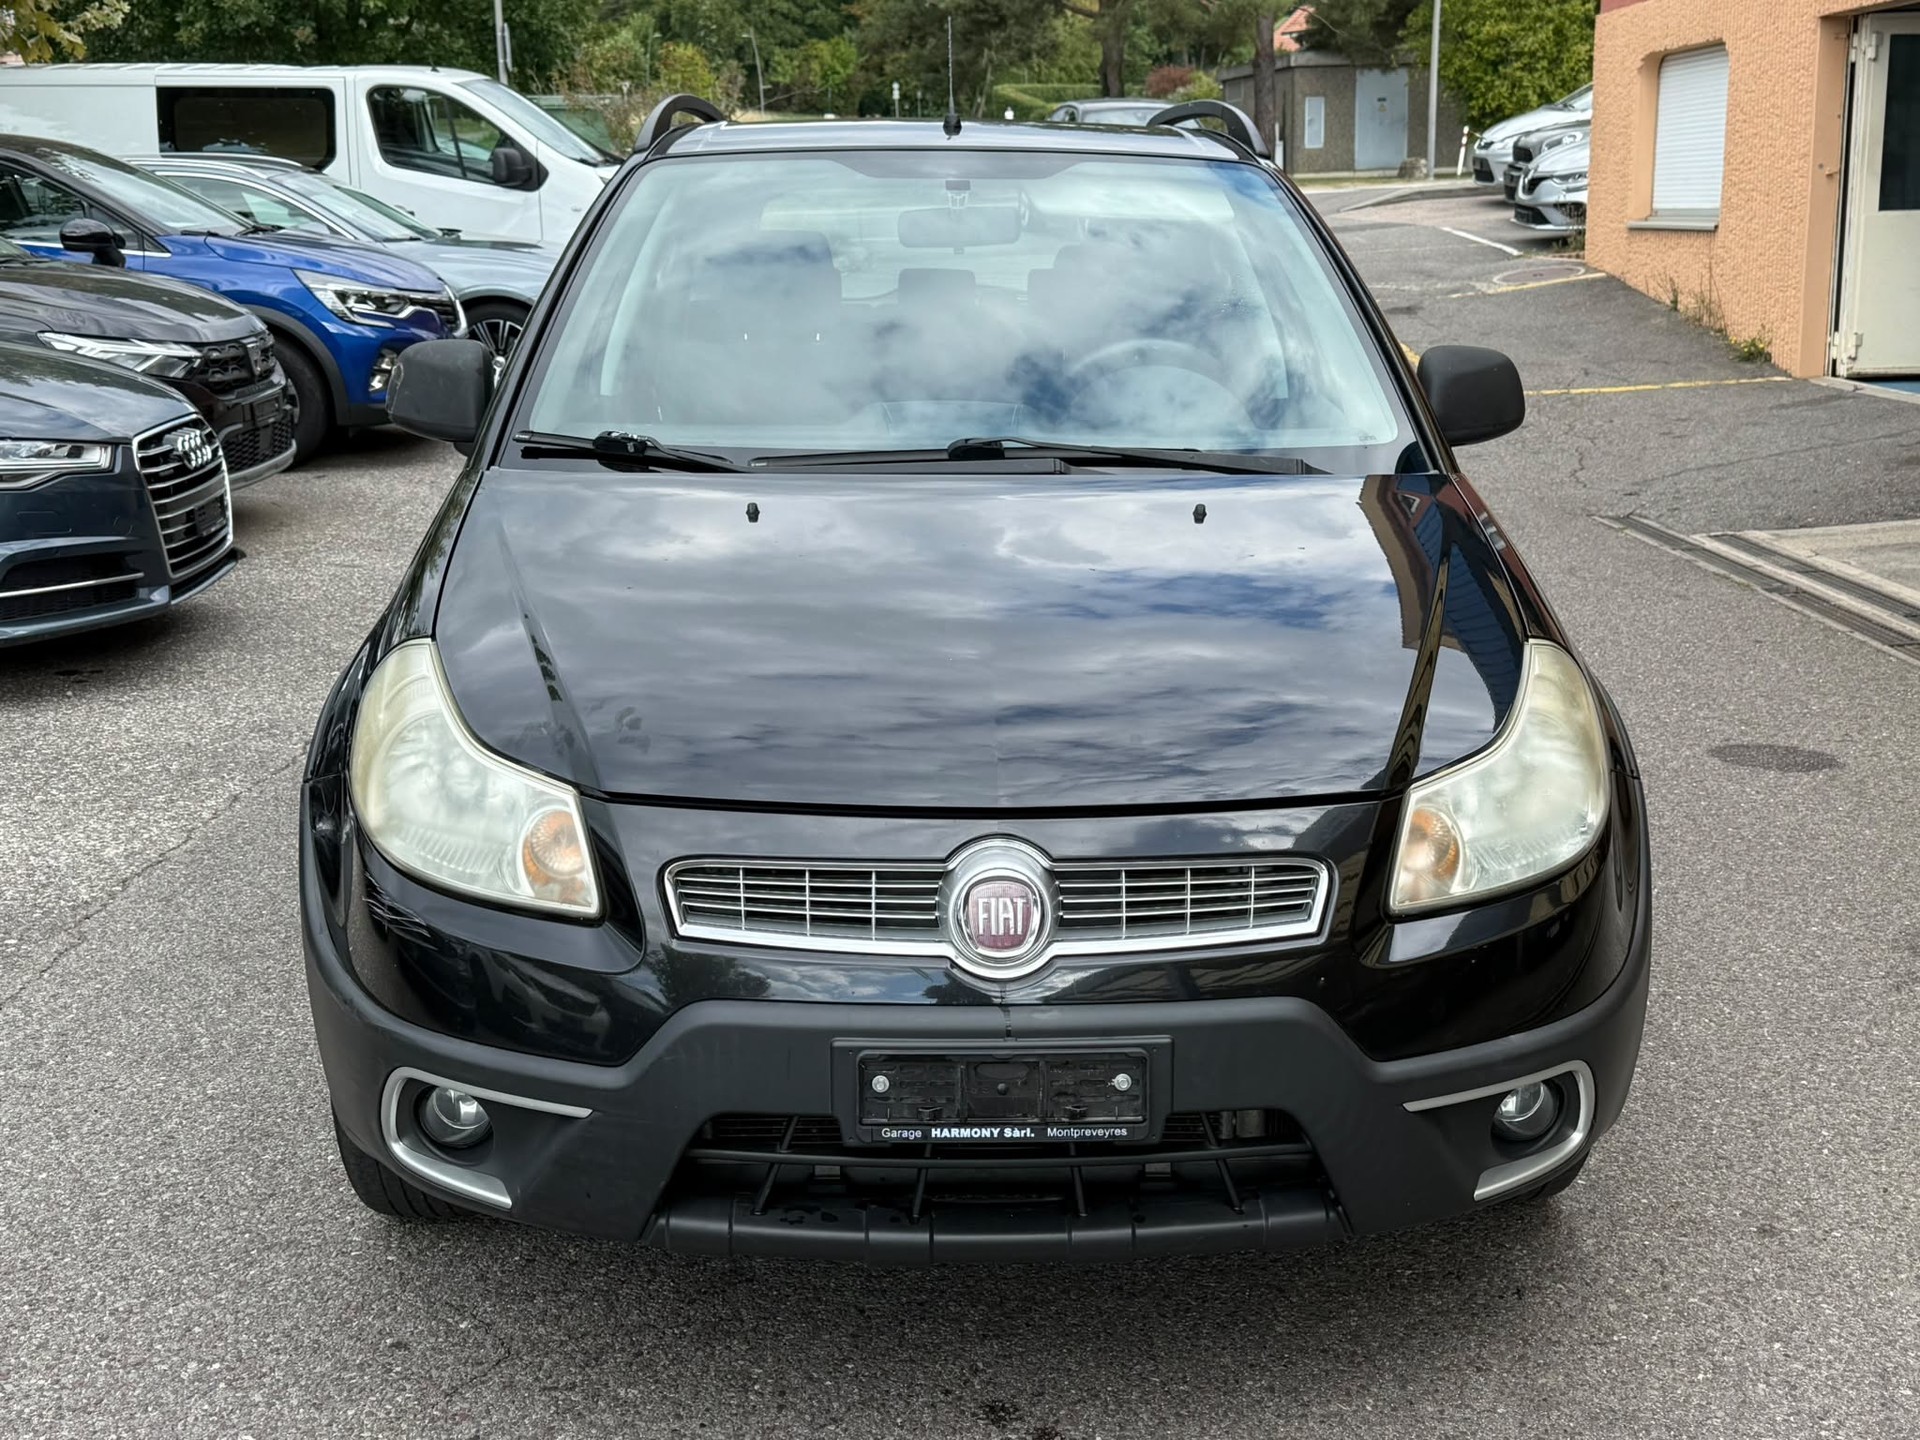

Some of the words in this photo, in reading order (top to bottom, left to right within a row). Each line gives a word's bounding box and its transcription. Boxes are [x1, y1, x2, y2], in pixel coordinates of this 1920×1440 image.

[977, 897, 1027, 936] FIAT
[881, 1127, 922, 1140] Garage
[931, 1127, 1000, 1138] HARMONY
[1047, 1126, 1128, 1139] Montpreveyres
